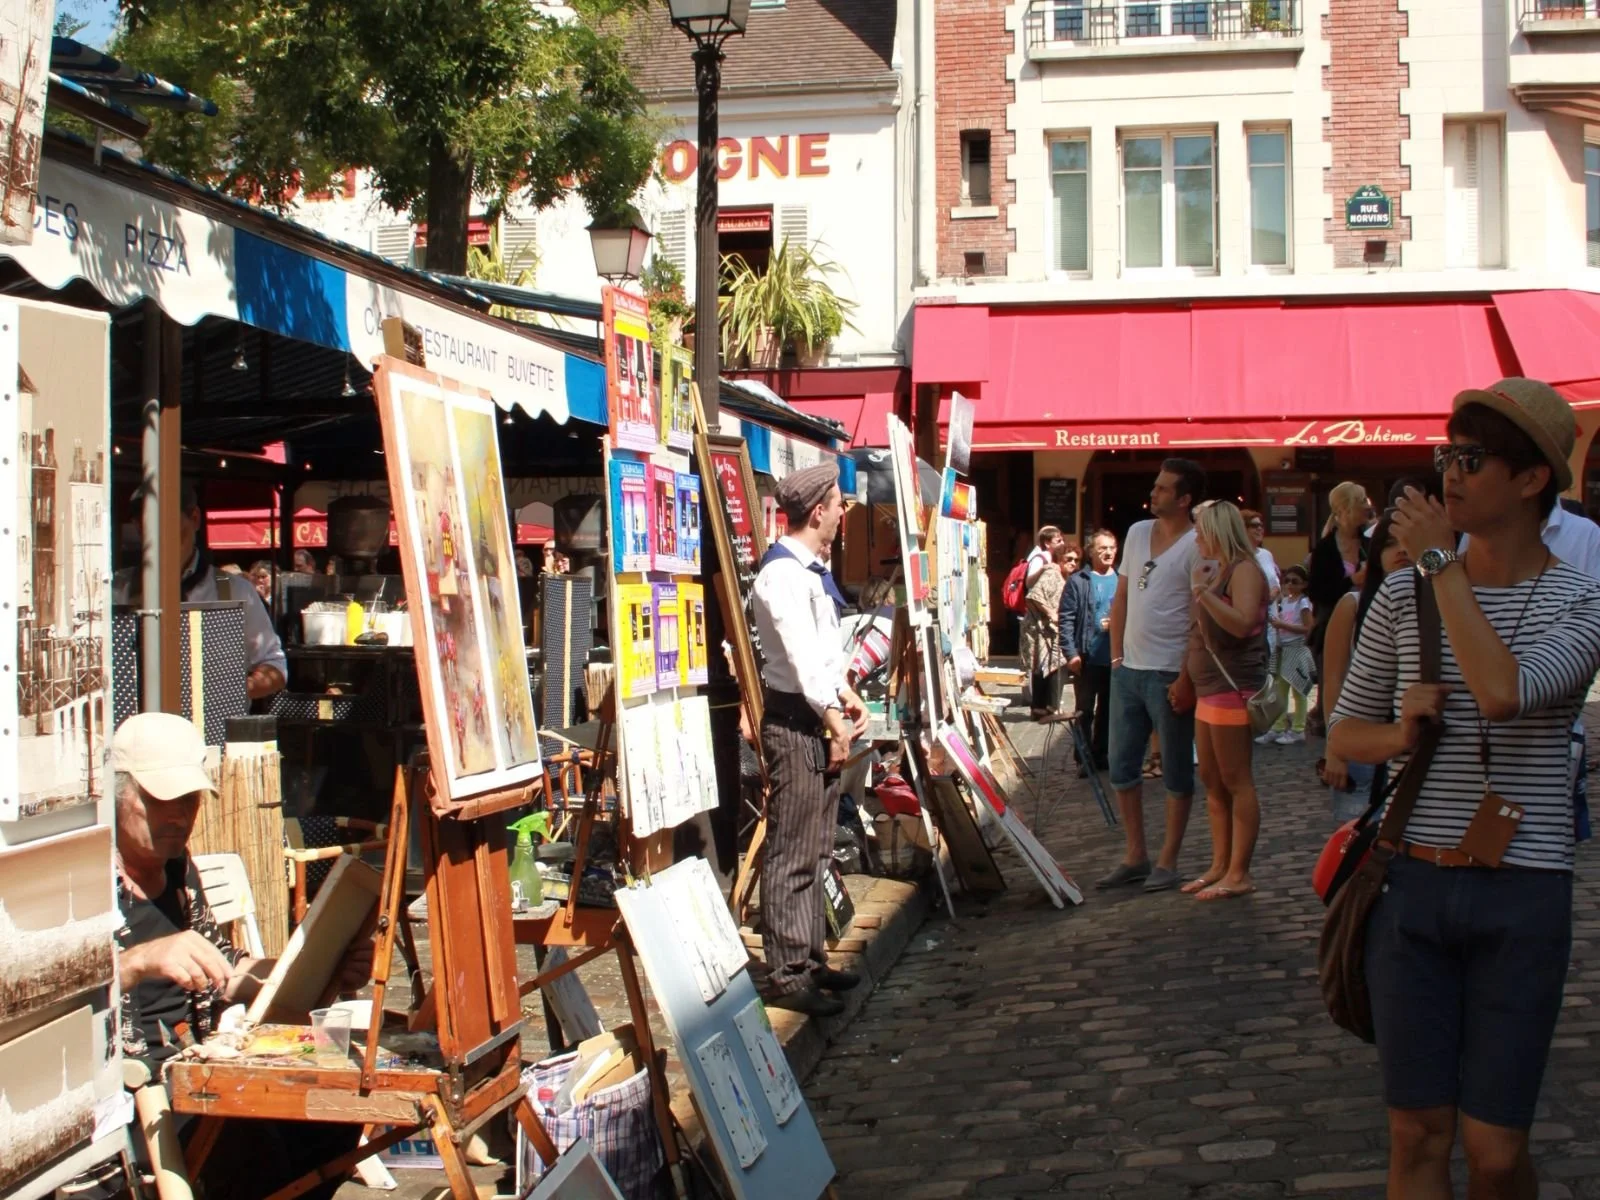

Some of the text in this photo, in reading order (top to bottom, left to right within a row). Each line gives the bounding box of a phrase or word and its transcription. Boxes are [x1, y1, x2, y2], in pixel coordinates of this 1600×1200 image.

[659, 133, 830, 184] OGNE
[1350, 214, 1389, 223] NORVINS
[1360, 204, 1378, 213] RUE
[124, 223, 191, 277] PIZZA
[507, 354, 555, 392] BUVETTE
[1055, 420, 1416, 447] Restaurant La Bohème
